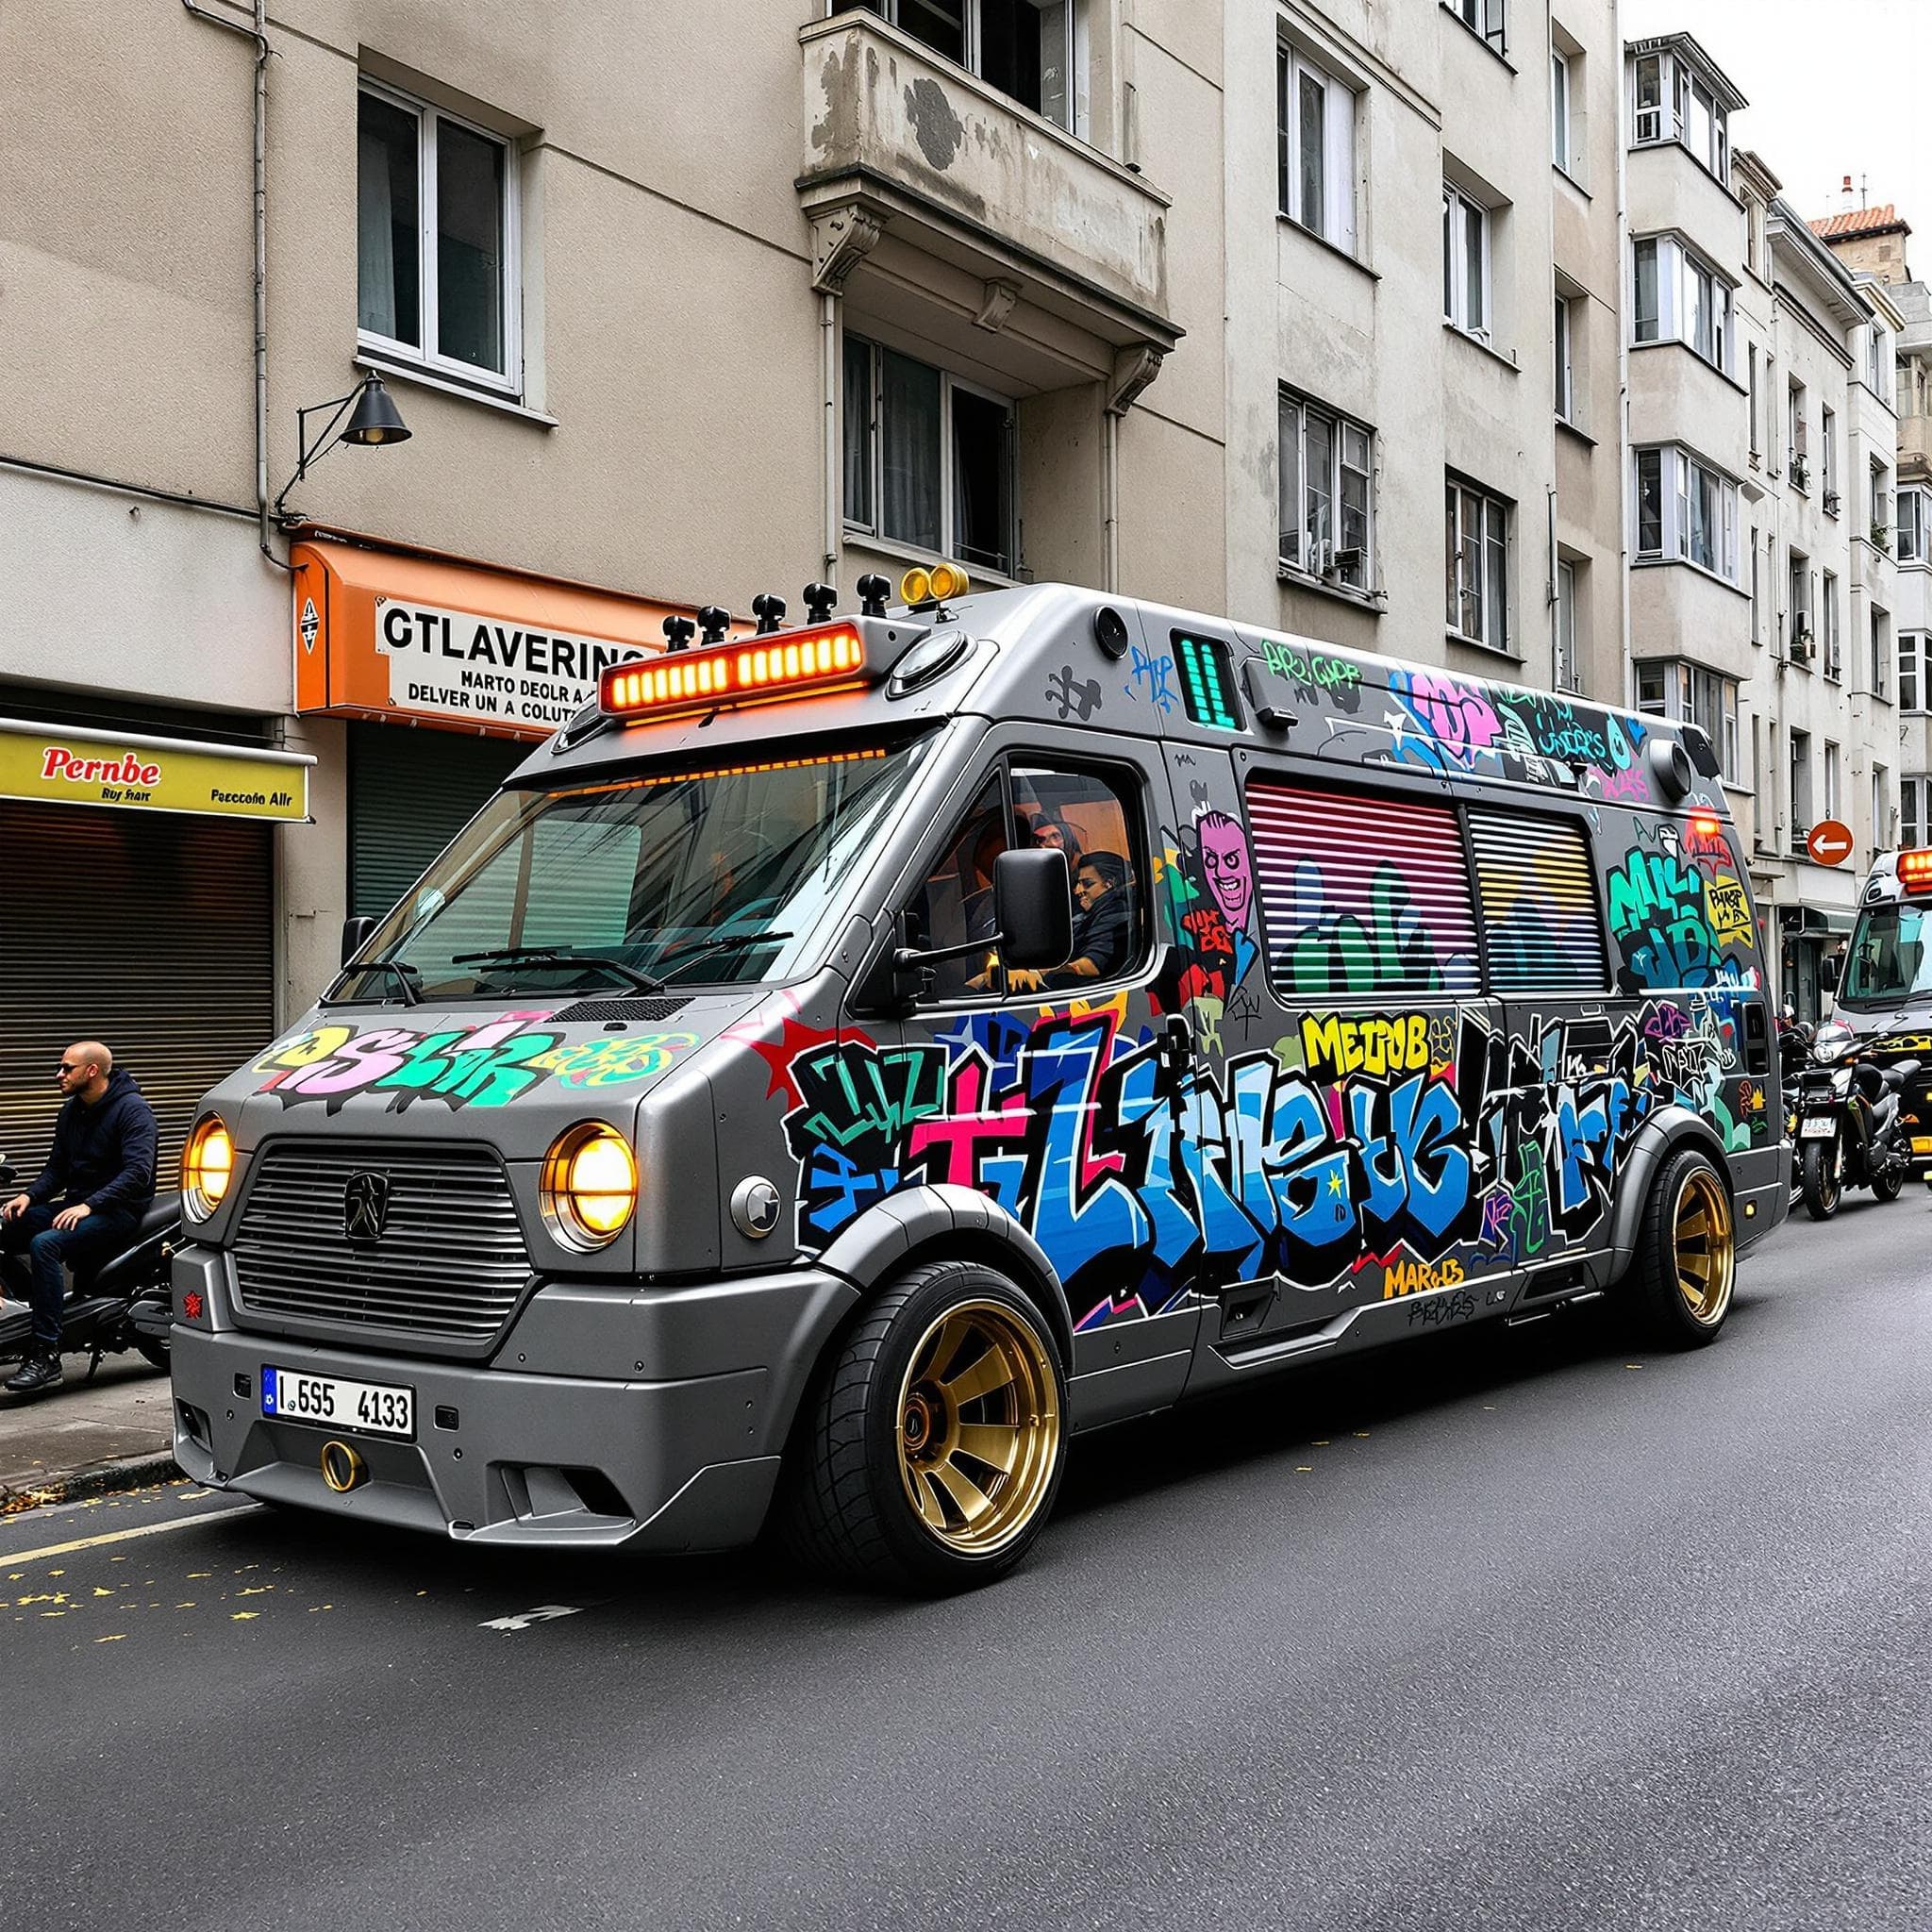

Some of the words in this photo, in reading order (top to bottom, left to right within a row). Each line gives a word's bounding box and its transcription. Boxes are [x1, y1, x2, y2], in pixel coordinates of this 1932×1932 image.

[408, 682, 470, 709] DELVER
[475, 693, 498, 713] UN
[504, 700, 515, 715] A
[460, 670, 516, 694] MARTO
[42, 747, 162, 787] Pernbe
[358, 1391, 408, 1429] 4133
